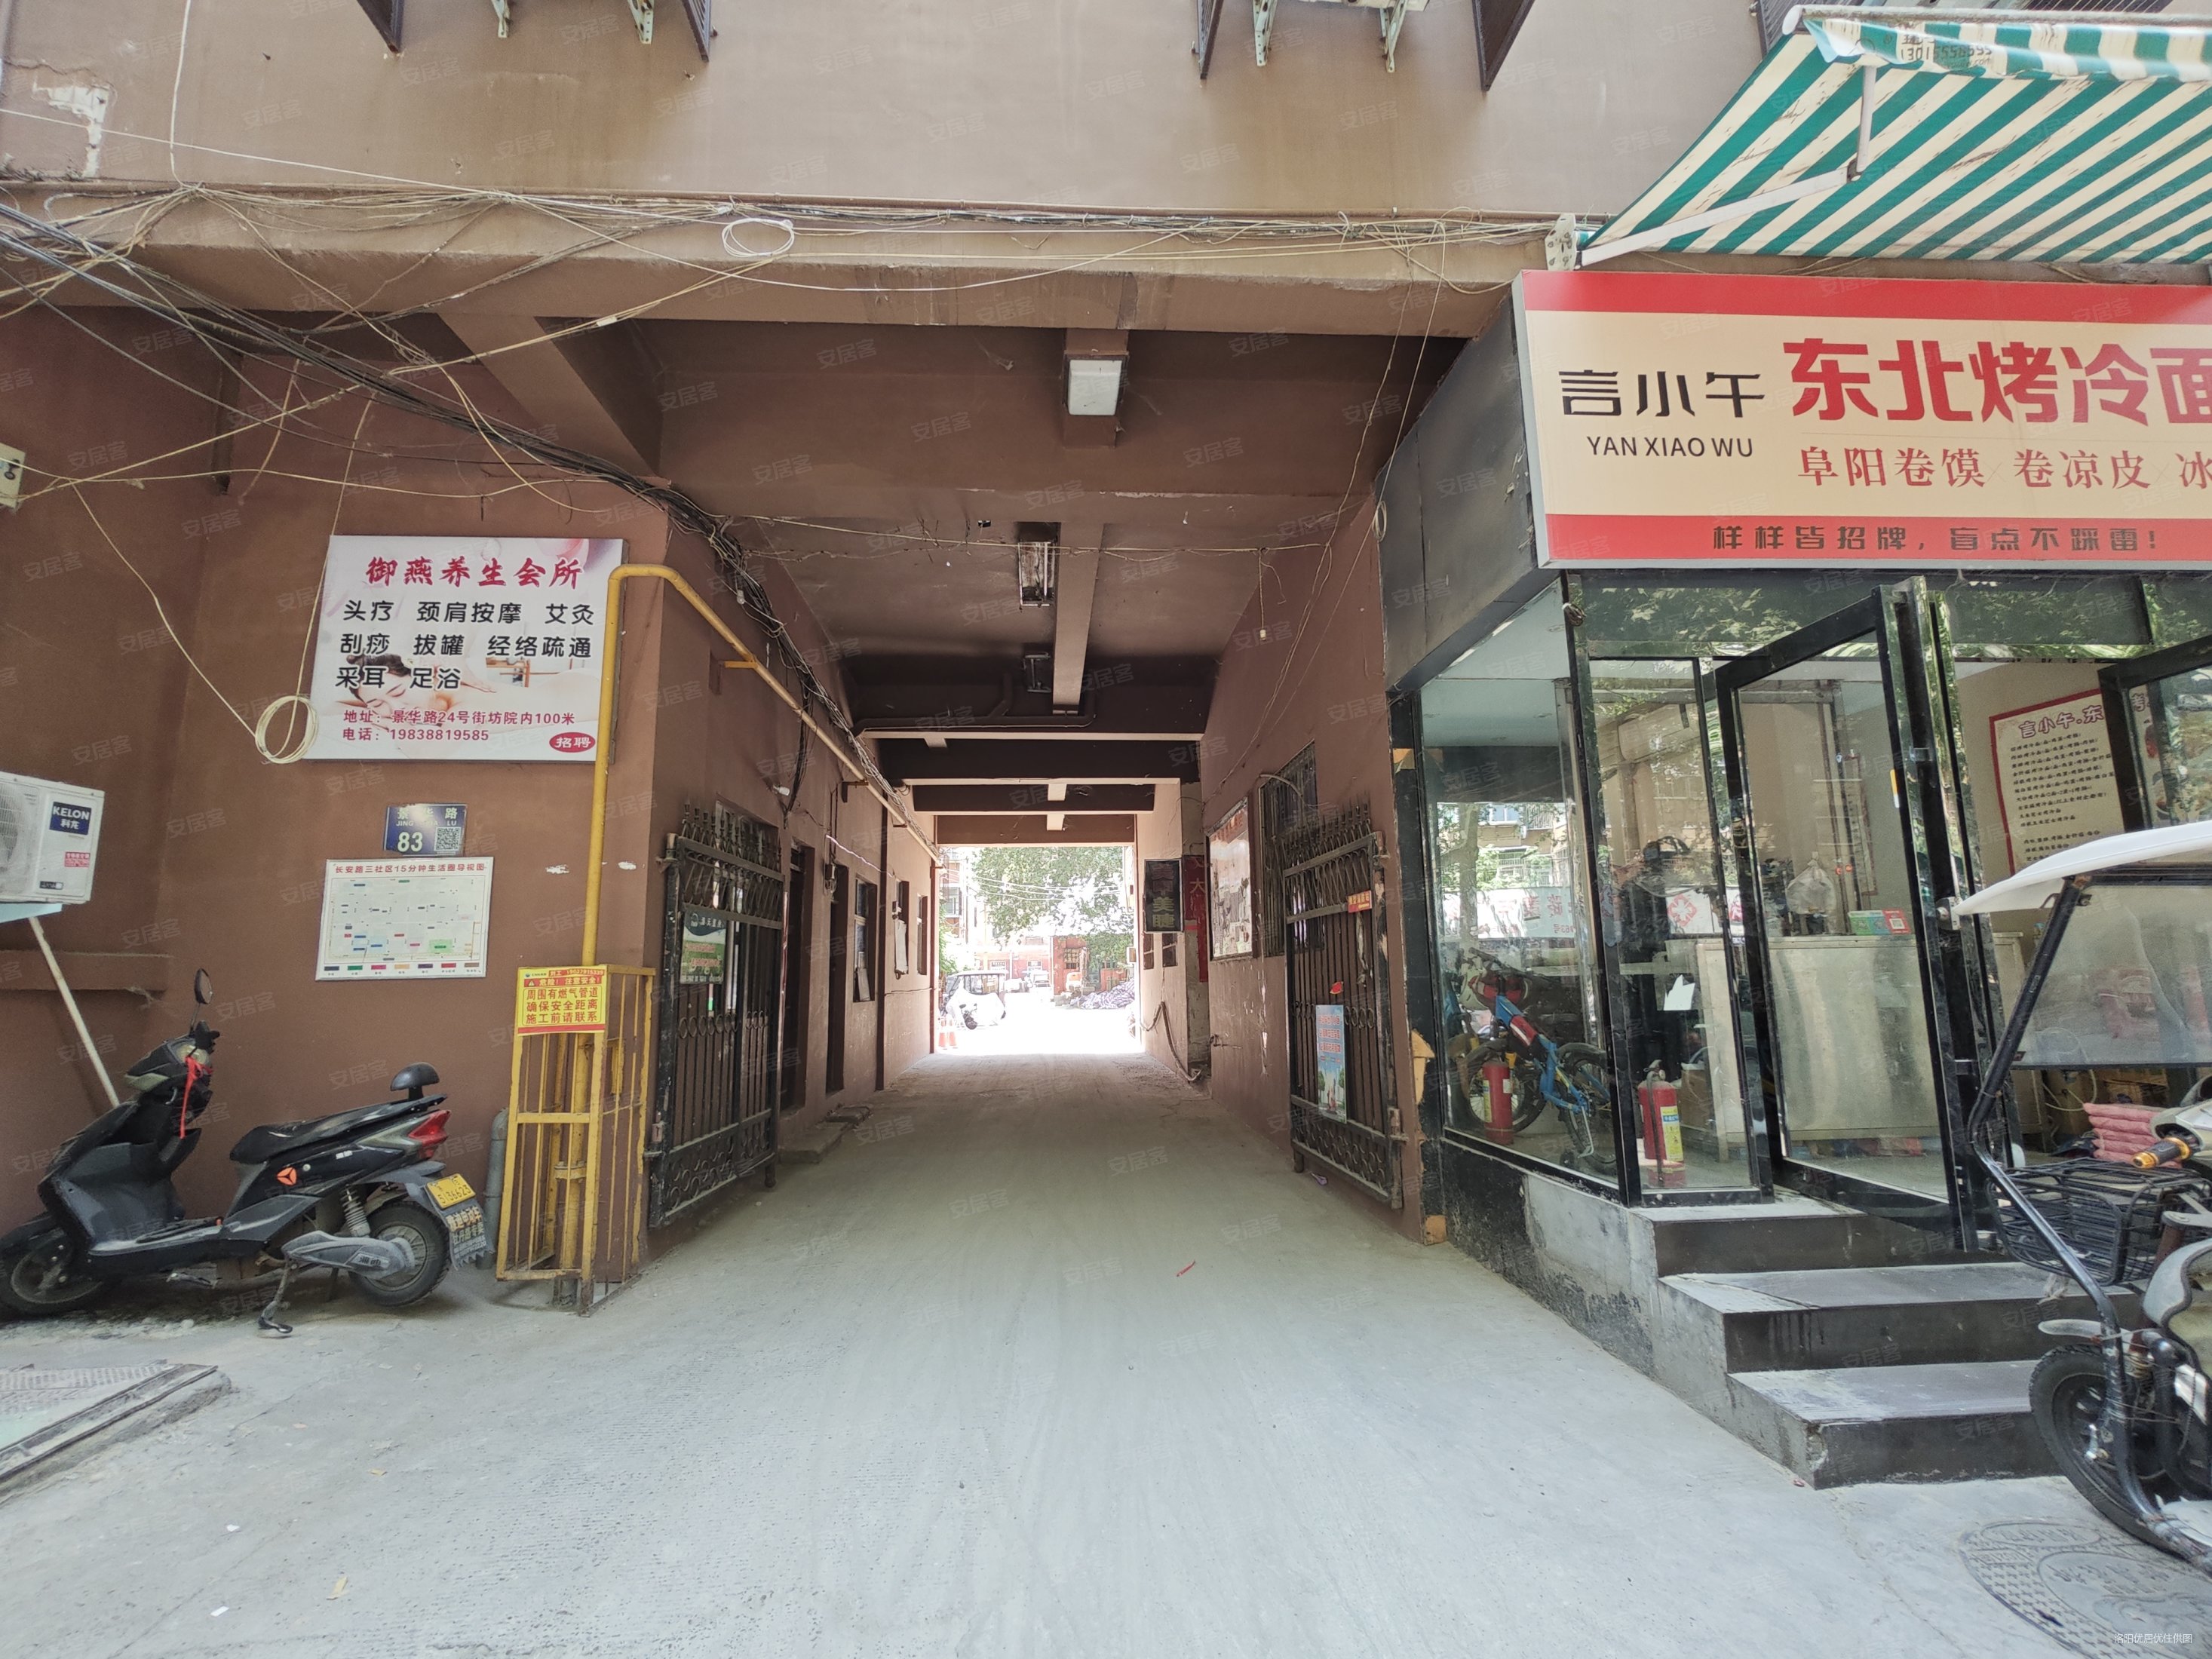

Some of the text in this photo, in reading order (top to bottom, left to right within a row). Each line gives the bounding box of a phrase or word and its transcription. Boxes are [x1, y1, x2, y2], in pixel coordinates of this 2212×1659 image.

[1782, 337, 2212, 428] 东北烤冷面
[1558, 370, 1766, 419] 言小午
[1587, 436, 1754, 458] YAN XIAO WU
[1798, 446, 1987, 489] 阜阳卷馍
[2014, 448, 2152, 490] 卷凉皮
[366, 557, 583, 590] 御燕养生会所
[343, 600, 594, 626] 头疗 颈肩按摩 艾灸
[340, 633, 592, 658] 刮痧 拔罐 经络疏通
[335, 667, 461, 689] 采耳 足浴
[554, 737, 591, 749] 招聘
[53, 806, 90, 820] KELON
[60, 818, 79, 830] 科龙
[397, 832, 423, 852] 83
[526, 987, 598, 1000] 周围有燃气管道
[526, 999, 598, 1012] 确保安全距离
[526, 1011, 597, 1024] 施工前请联系
